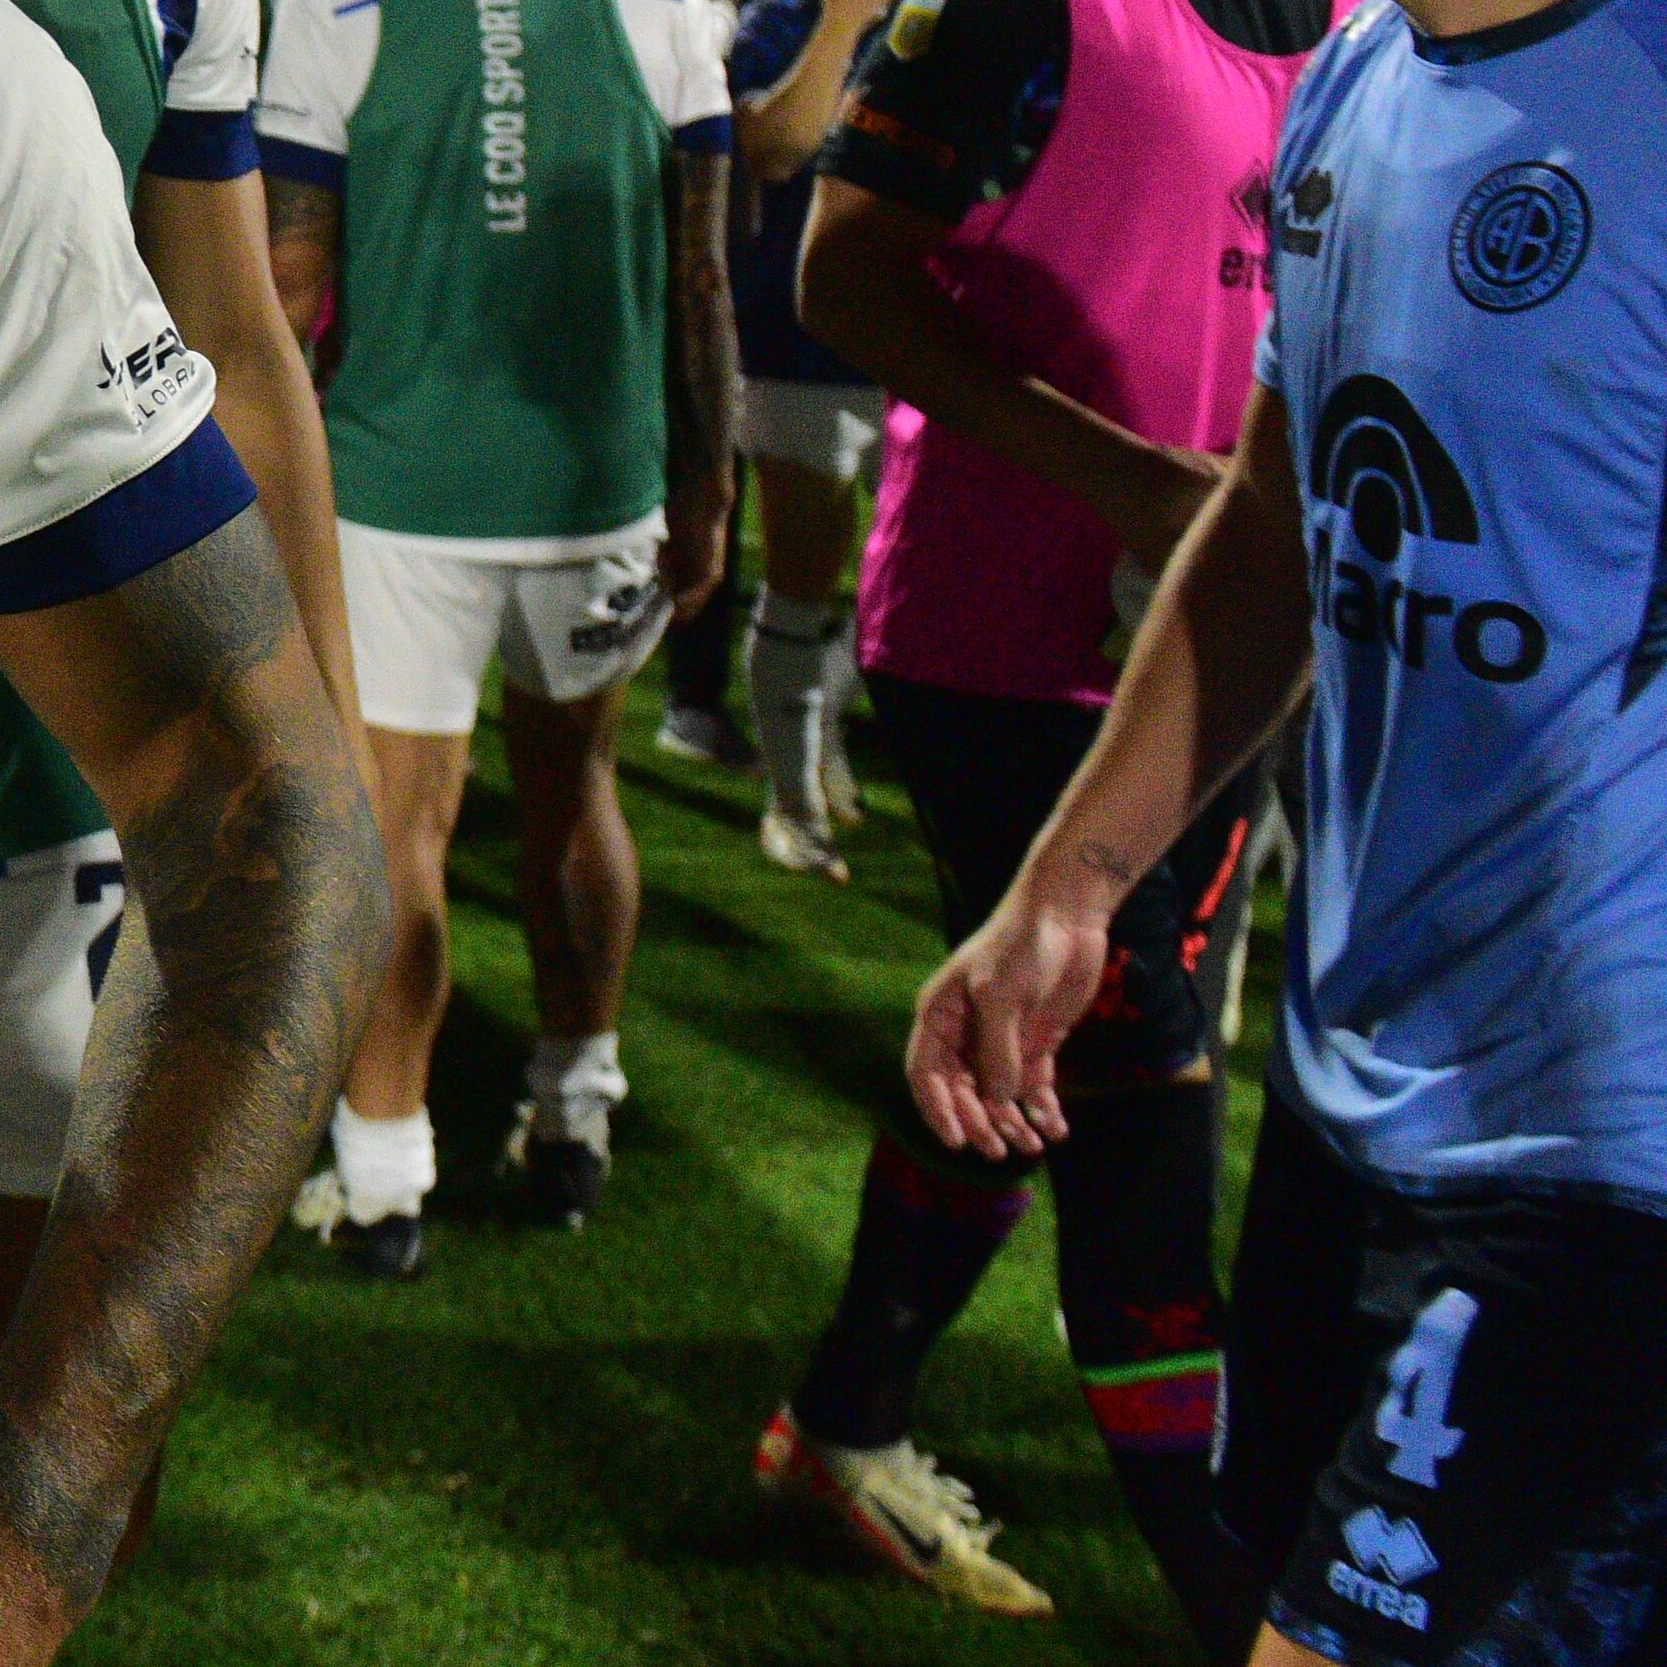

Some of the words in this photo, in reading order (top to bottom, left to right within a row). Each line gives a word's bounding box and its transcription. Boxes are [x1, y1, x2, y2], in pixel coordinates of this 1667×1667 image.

[484, 188, 527, 233] LE
[1374, 1286, 1481, 1490] 4
[1326, 1559, 1432, 1633] errea
